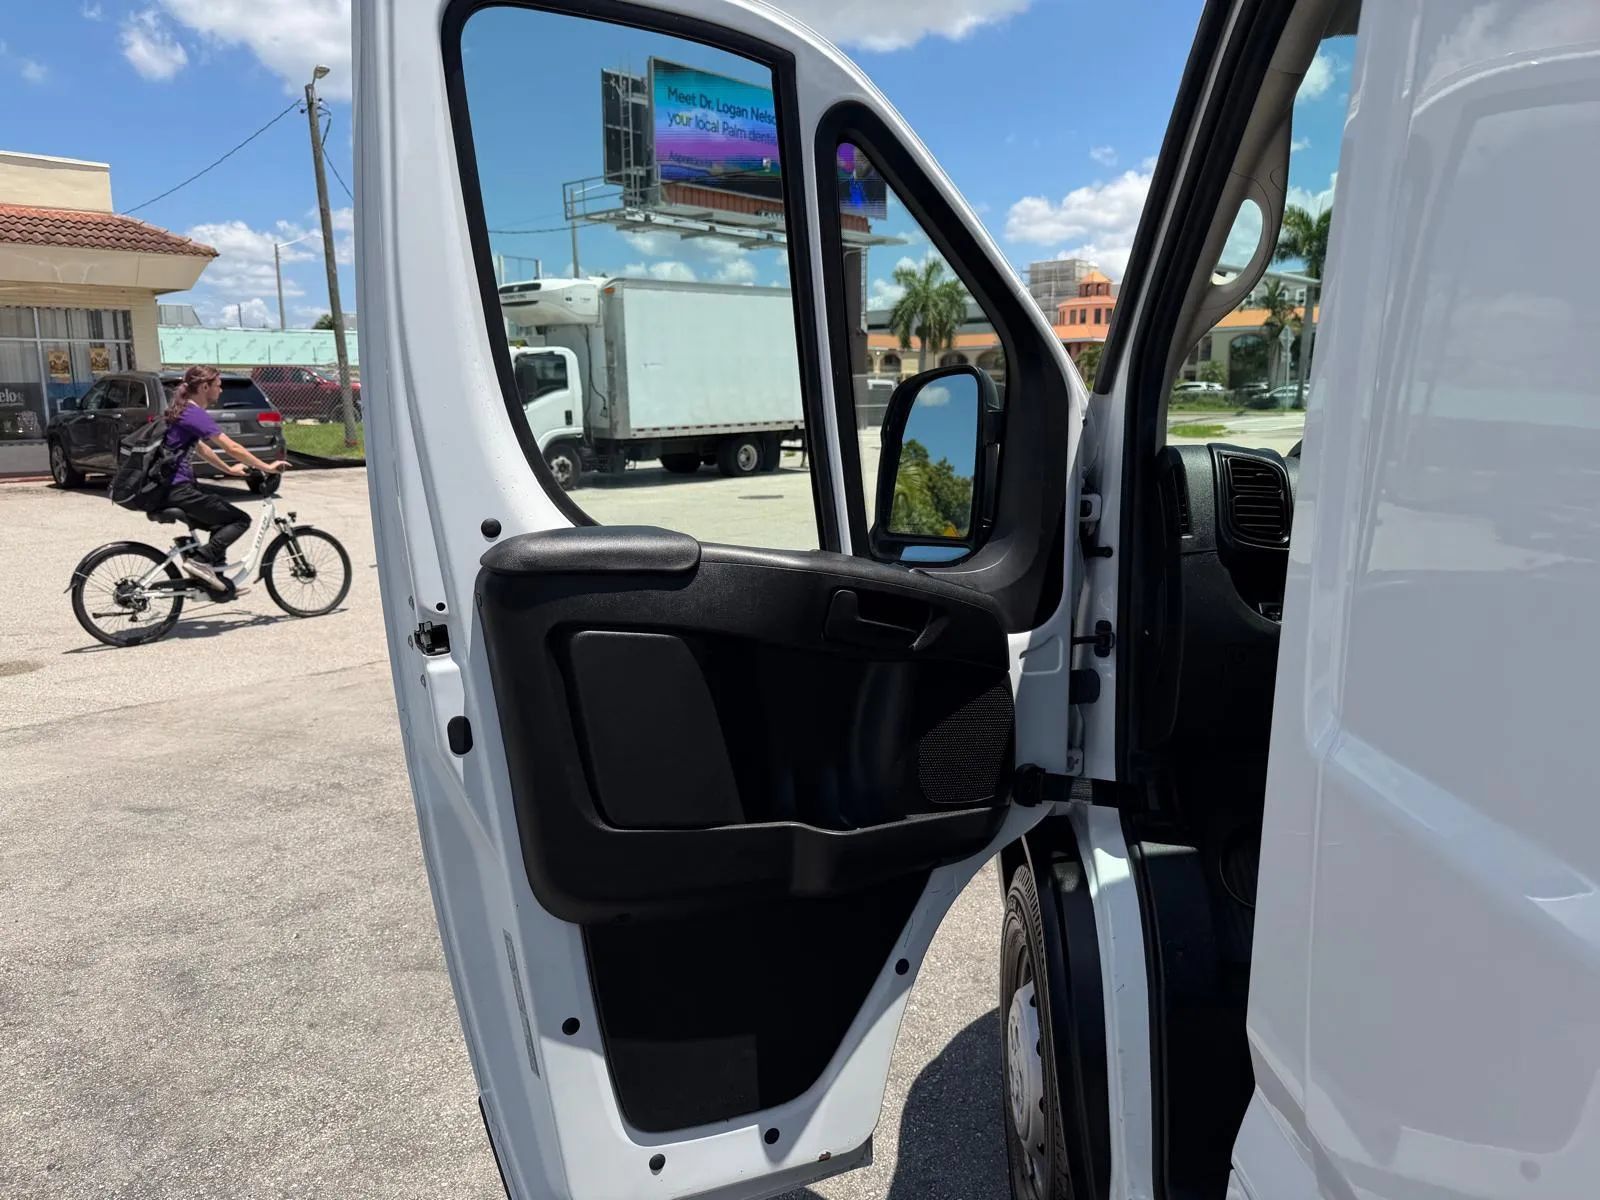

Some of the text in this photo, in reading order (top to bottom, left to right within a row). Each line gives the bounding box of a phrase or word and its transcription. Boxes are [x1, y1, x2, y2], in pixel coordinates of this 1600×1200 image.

[667, 86, 696, 106] Meet
[700, 94, 714, 109] Dr.
[717, 98, 748, 120] Logan
[667, 112, 692, 127] your
[695, 115, 719, 133] local
[722, 121, 746, 139] Palm
